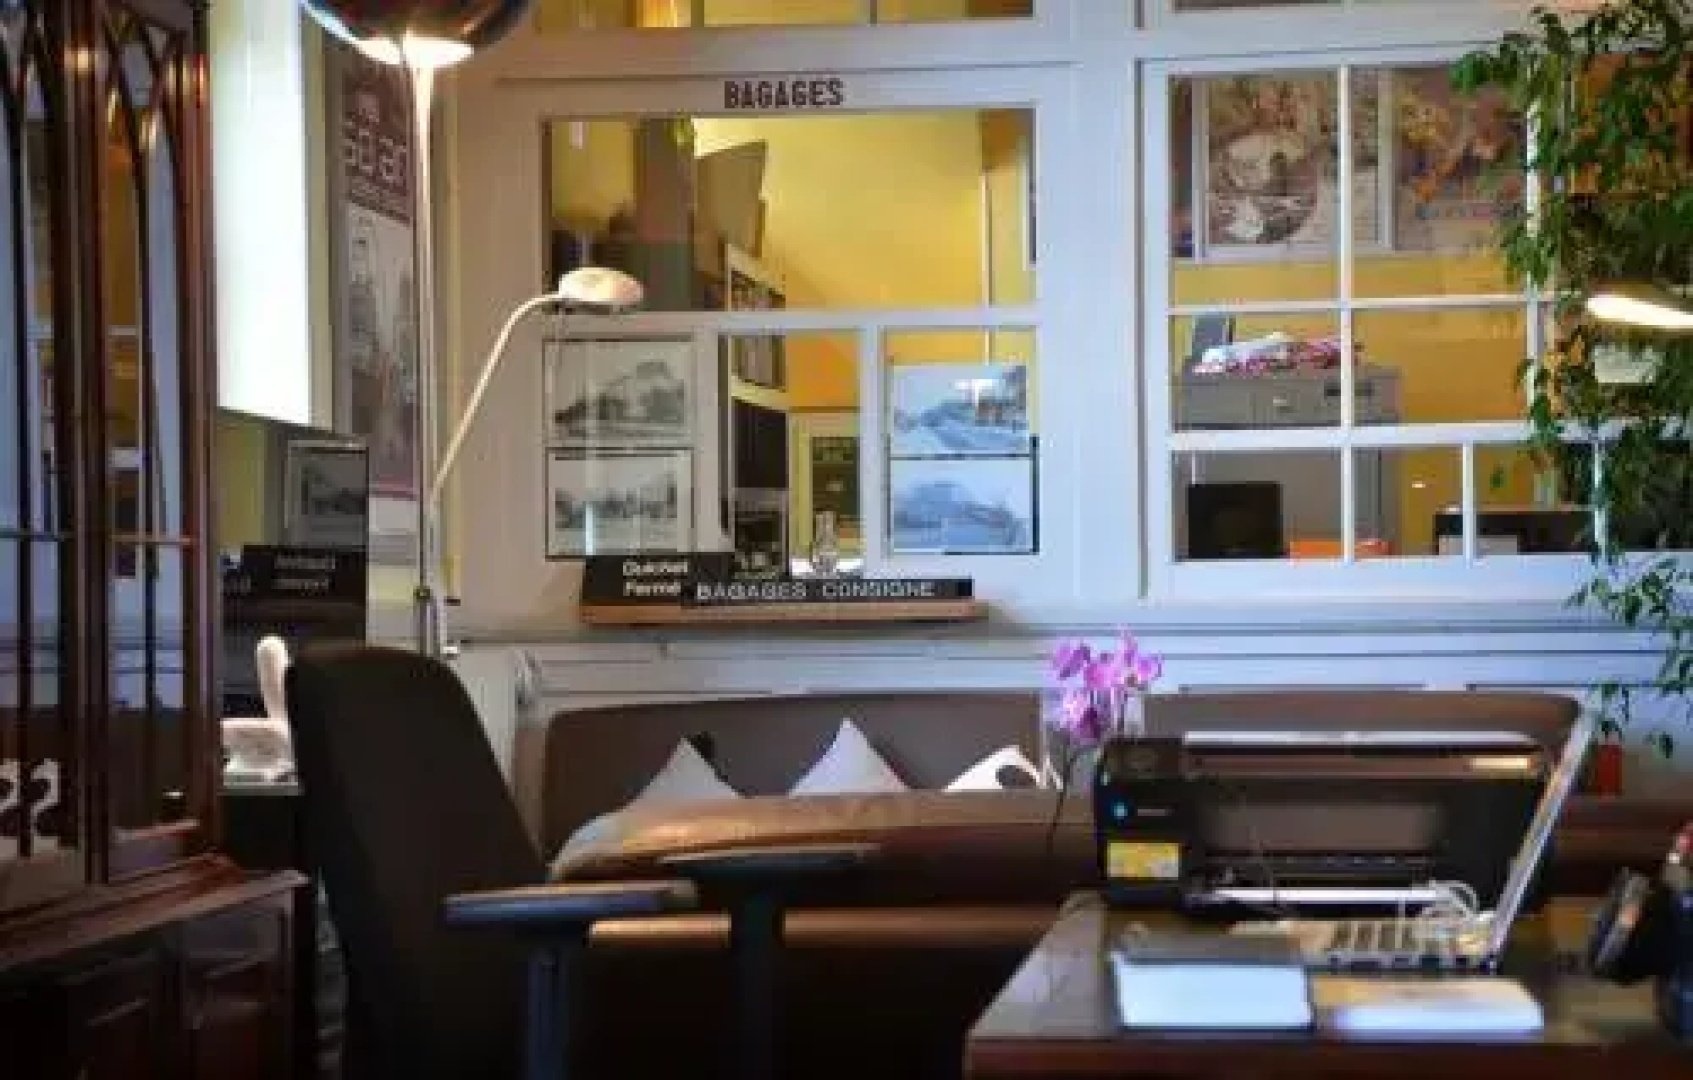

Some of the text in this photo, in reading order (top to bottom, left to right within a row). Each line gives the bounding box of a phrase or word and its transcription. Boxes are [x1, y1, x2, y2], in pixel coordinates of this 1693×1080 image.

[724, 78, 844, 109] BAGAGES
[695, 579, 936, 601] BAGAGES CONSIGNE
